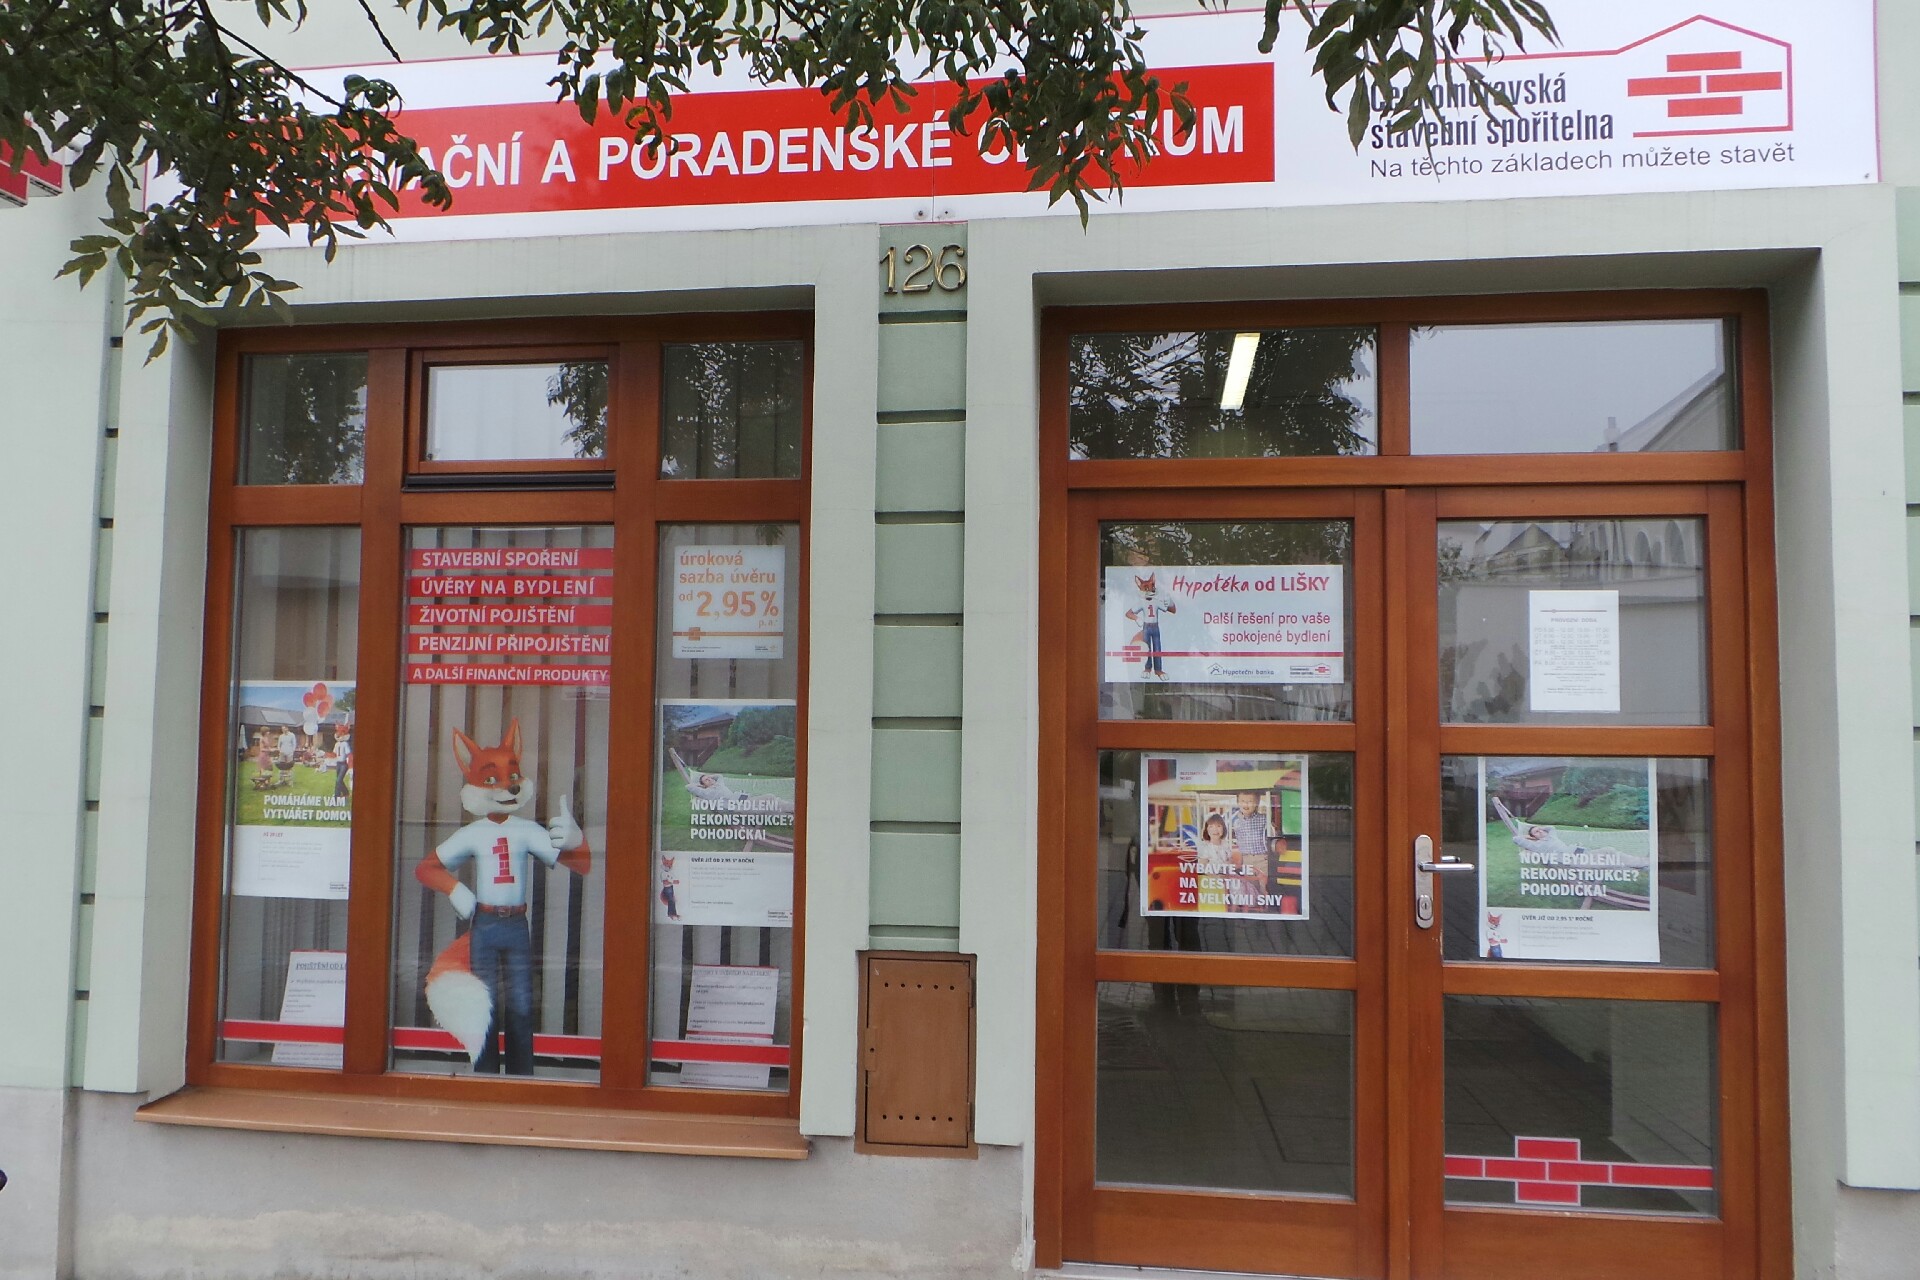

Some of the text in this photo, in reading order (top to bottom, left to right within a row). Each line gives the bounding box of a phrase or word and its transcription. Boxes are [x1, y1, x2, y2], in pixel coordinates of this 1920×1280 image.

[1371, 109, 1614, 149] stavební spořitelna
[541, 139, 577, 183] A
[598, 109, 953, 181] PORADENSKÉ
[1371, 143, 1796, 178] Na těchto základech můžete stavět
[879, 243, 967, 295] 126
[422, 549, 578, 567] STAVEBNÍ SPOŘENÍ
[680, 550, 743, 566] úroková
[679, 568, 776, 584] sazba úvěru
[421, 577, 595, 595] ÚVĚRY NA BYDLENÍ
[1172, 572, 1330, 599] Hypotéka od LIŠKY
[678, 590, 694, 602] od
[419, 605, 576, 624] ŽIVOTNÍ POJIŠTĚNÍ
[1203, 611, 1331, 628] Další řešení pro vaše
[419, 634, 610, 653] PENZIJNÍ PŘIPOJIŠTĚNÍ
[1222, 629, 1331, 644] spokojené bydlení
[413, 666, 608, 681] A DALŠÍ FINANČNÍ PRODUKTY
[263, 793, 346, 807] POMÁHÁME VÁM
[263, 808, 314, 821] VYTVÁŘET
[690, 813, 794, 826] REKONSTRUKCE?
[690, 826, 766, 841] POHODIČKA!
[1179, 862, 1254, 876] VYBAVTE JE
[1520, 867, 1640, 882] REKONSTRUKCE?
[1179, 877, 1241, 890] NA CESTU
[1520, 881, 1607, 897] POHODIČKA!
[1179, 891, 1283, 906] ZA VELKÝMI SNY
